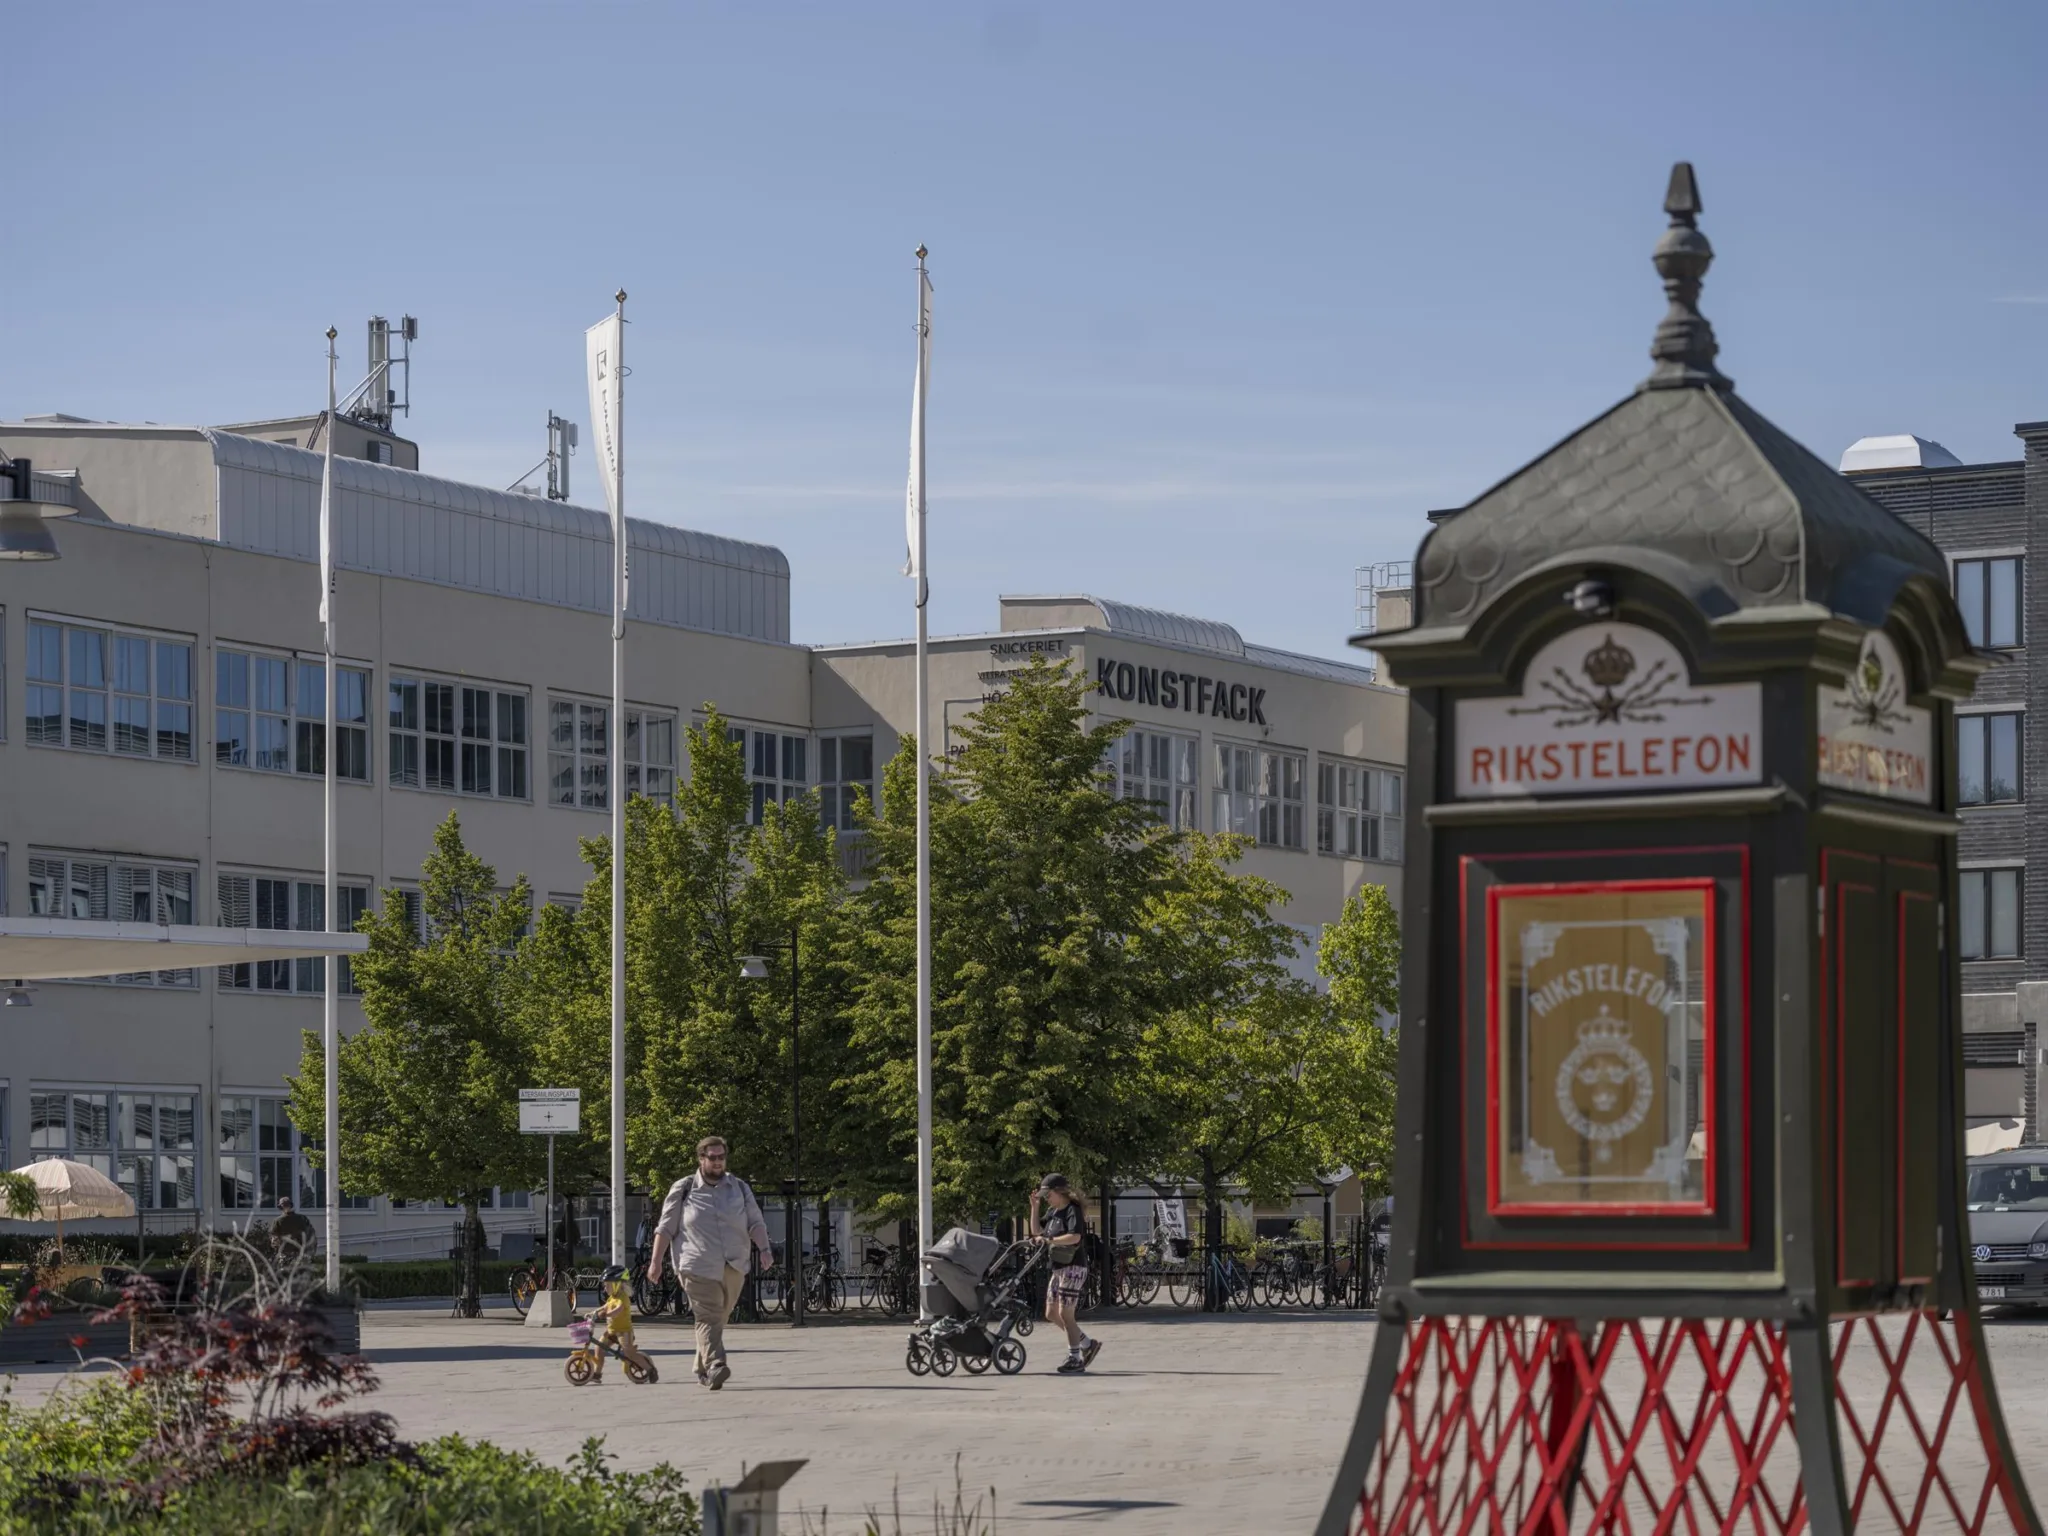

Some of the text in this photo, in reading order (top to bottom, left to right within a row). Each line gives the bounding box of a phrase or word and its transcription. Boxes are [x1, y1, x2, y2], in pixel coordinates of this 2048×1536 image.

[990, 640, 1064, 655] SNICKERIET
[1097, 657, 1267, 726] KONSTFACK
[1471, 734, 1752, 785] RIKSTELEFON
[1529, 964, 1680, 1017] RIKSTELEFON
[1985, 1288, 2001, 1296] 781
